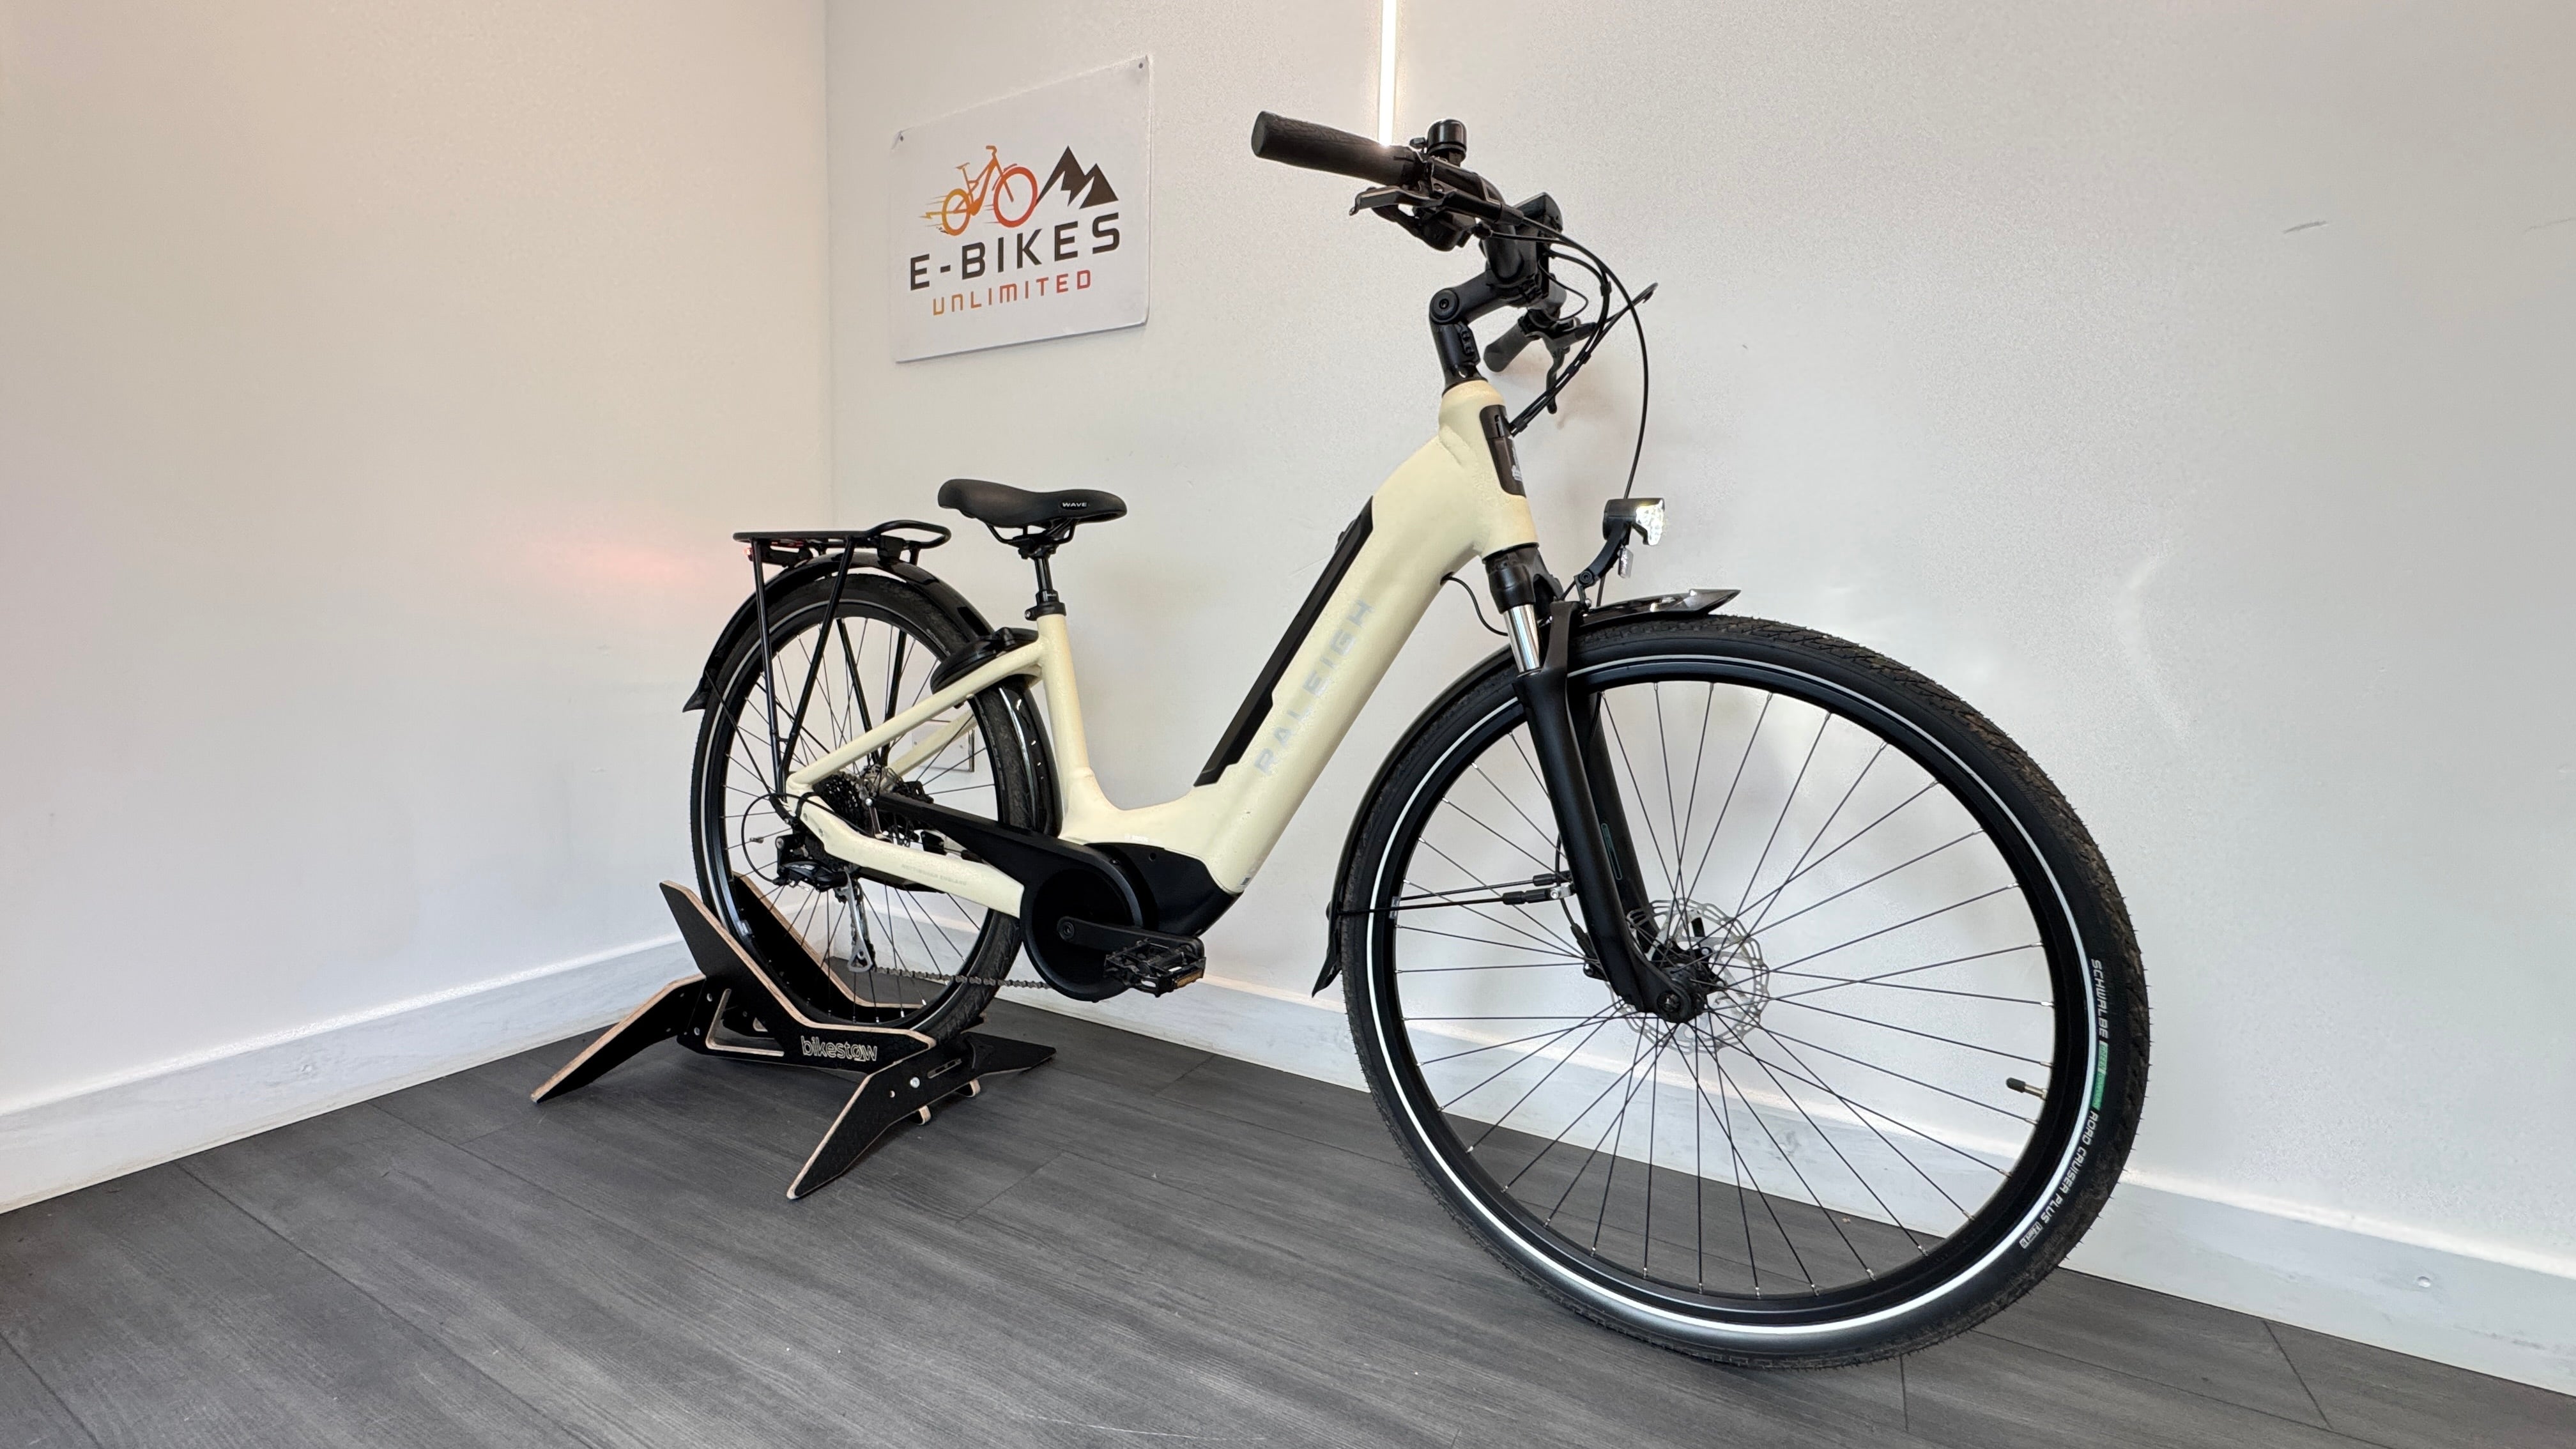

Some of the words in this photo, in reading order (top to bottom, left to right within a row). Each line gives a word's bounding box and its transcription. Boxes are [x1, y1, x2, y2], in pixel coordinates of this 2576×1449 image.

[910, 211, 1120, 291] E-BIKES
[932, 269, 1092, 316] UNLIMITED
[1253, 599, 1374, 777] RALEIGH
[2090, 958, 2109, 1039] SCHWALBE
[2082, 1110, 2099, 1146] ROAD
[2058, 1146, 2087, 1195] CRUISER
[2040, 1193, 2064, 1223] PLUS
